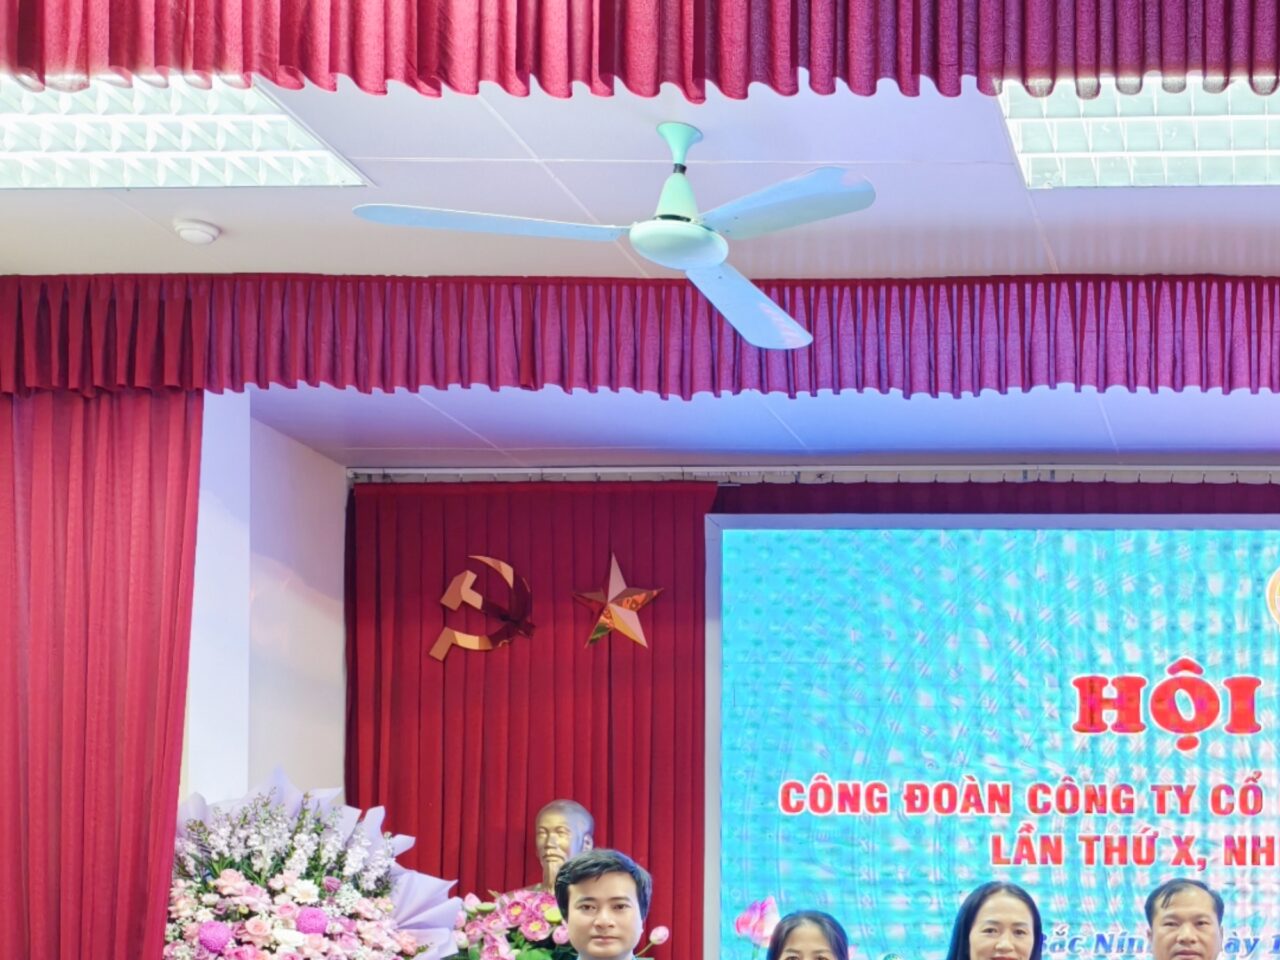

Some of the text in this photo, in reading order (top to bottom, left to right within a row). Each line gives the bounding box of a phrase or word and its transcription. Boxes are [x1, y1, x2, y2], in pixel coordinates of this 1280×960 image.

[1071, 657, 1263, 752] HỘI
[780, 774, 890, 815] CÔNG
[903, 775, 1013, 815] ĐOÀN
[1026, 775, 1136, 816] CÔNG
[1150, 784, 1197, 816] TY
[1210, 771, 1264, 816] CỔ
[991, 823, 1063, 866] LẦN
[1077, 827, 1160, 866] THỨ
[1170, 835, 1208, 872] X,
[1094, 931, 1153, 954] Nin
